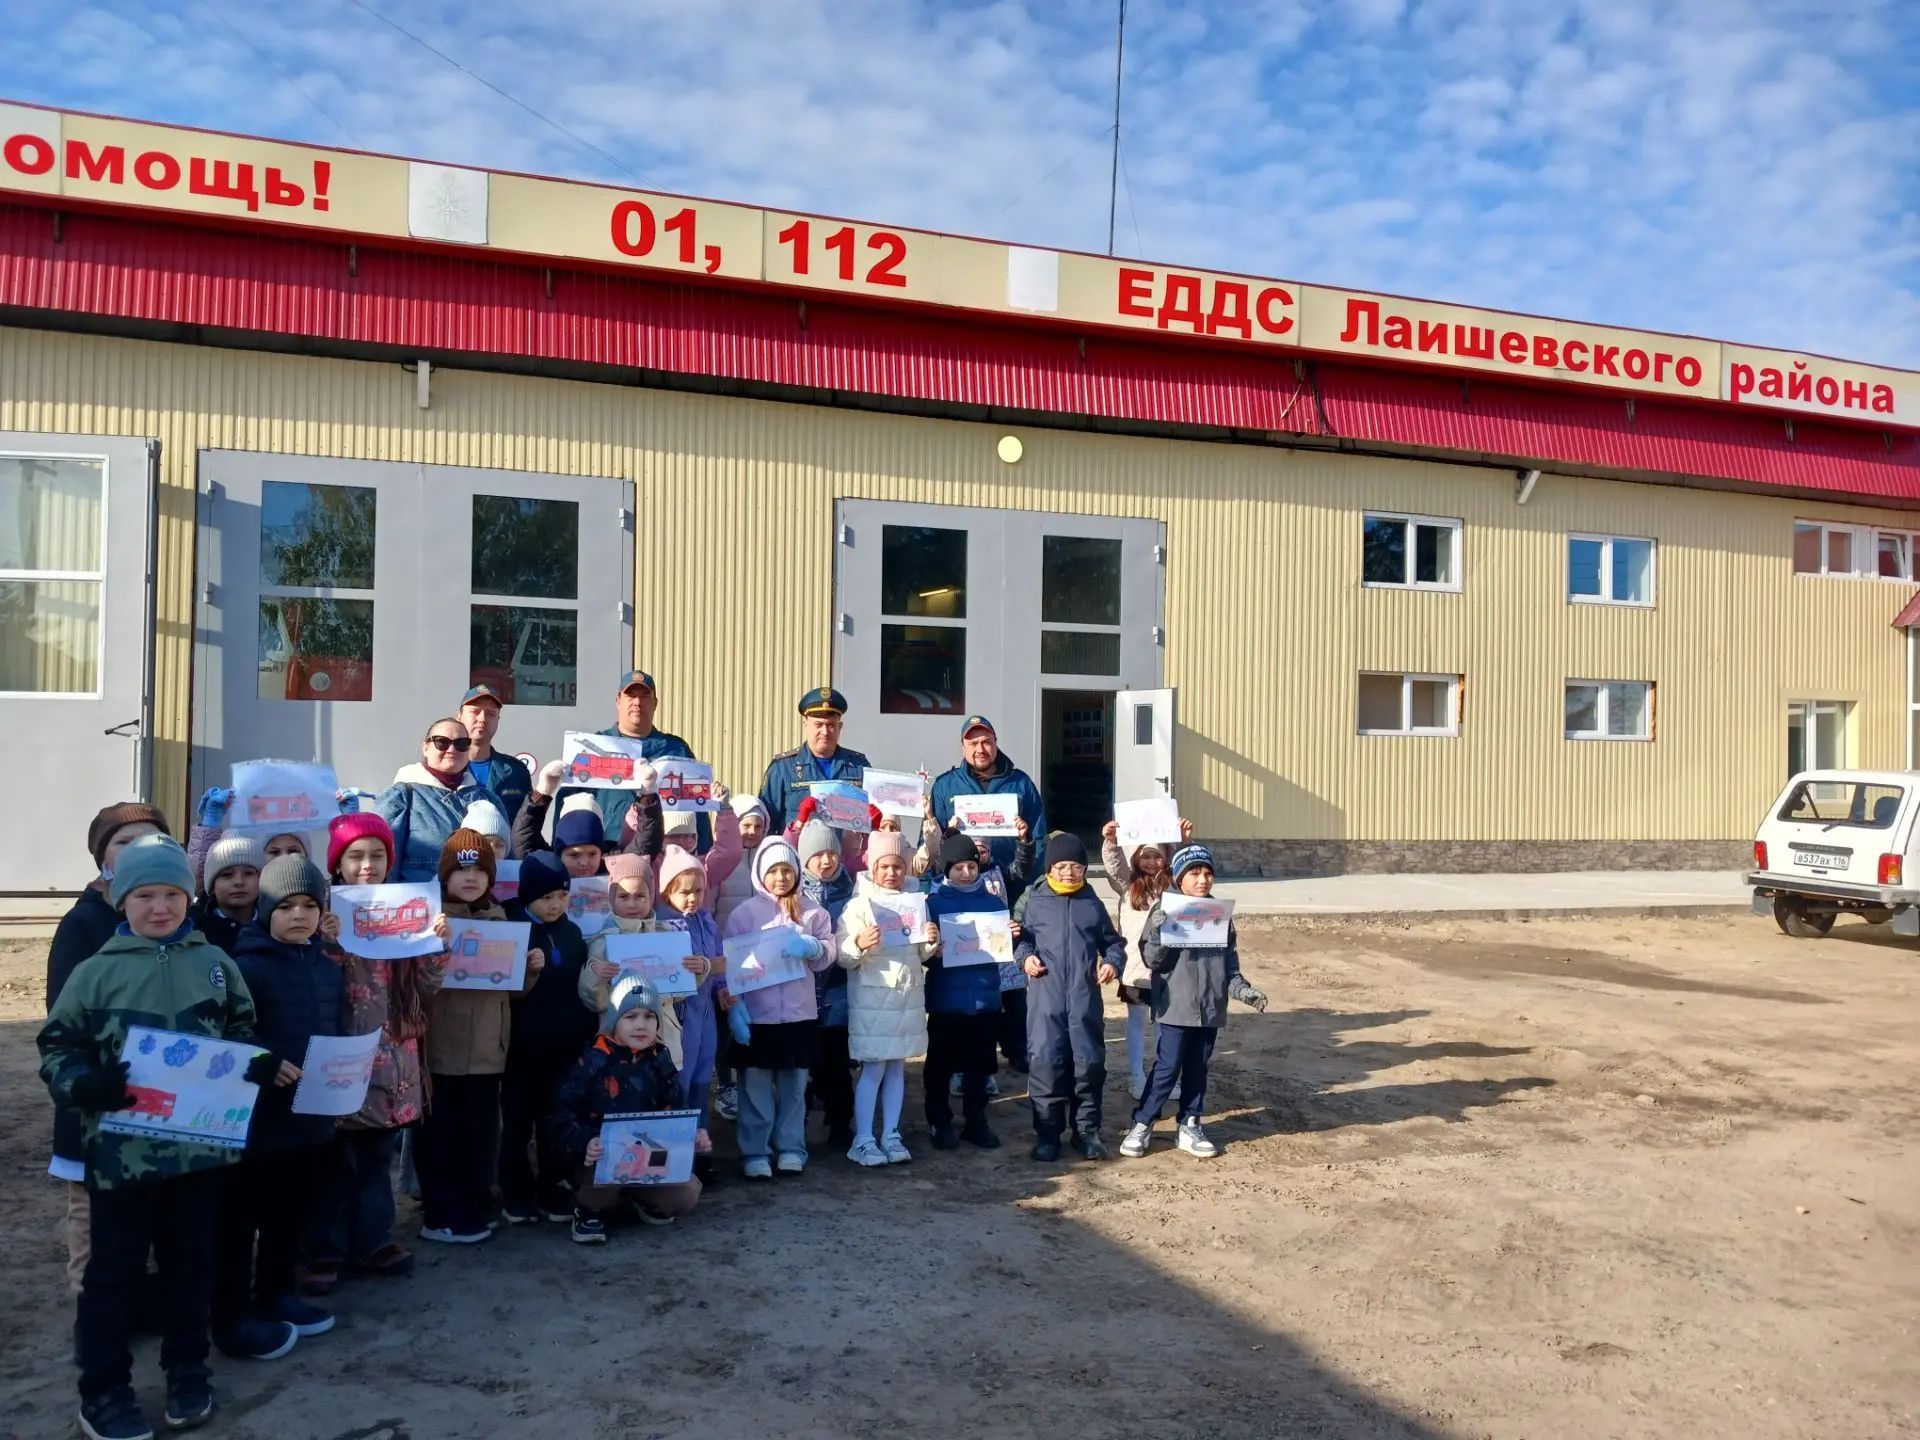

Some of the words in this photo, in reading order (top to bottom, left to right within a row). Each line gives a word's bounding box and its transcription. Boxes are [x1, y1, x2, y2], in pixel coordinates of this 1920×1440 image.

[3, 134, 331, 213] омощь!
[611, 200, 723, 275] 01,
[778, 220, 907, 287] 112
[1118, 268, 1294, 340] ЕДДС
[1340, 300, 1703, 387] Лаишевского
[1730, 360, 1895, 413] района
[456, 848, 479, 860] NYC
